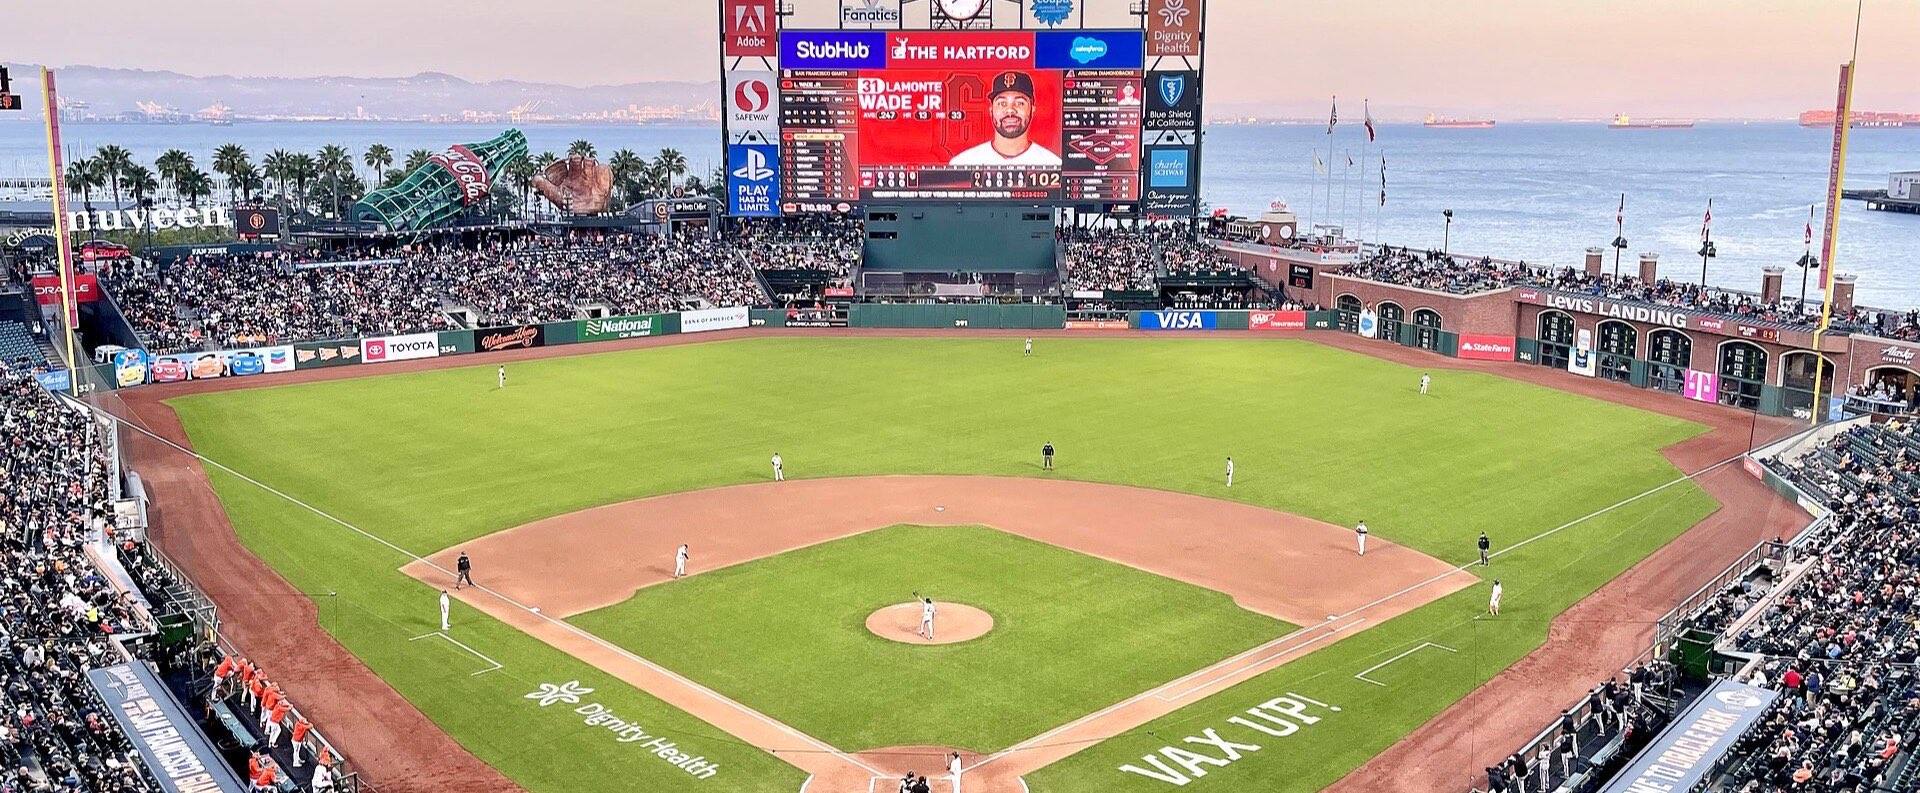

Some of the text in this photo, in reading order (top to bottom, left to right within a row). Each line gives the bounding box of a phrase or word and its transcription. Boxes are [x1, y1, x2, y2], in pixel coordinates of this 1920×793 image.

[843, 8, 898, 21] Fanatics
[737, 36, 765, 47] Adobe
[1154, 31, 1192, 42] Dignity
[796, 40, 870, 59] StubHub
[908, 46, 1030, 59] THE HARTFORD
[862, 80, 942, 92] 31 LAMONTE
[859, 95, 941, 110] WADE JR
[735, 113, 769, 121] SAFEWAY
[1150, 110, 1192, 118] Blue Shield
[1147, 119, 1155, 127] of
[1156, 119, 1194, 127] California
[1154, 159, 1184, 169] charles
[738, 185, 769, 195] PLAY
[1147, 190, 1189, 203] Own your
[1147, 200, 1190, 209] tomorrow
[68, 206, 230, 232] nuveen
[35, 283, 89, 295] ORALE
[1154, 312, 1203, 329] VISA
[1598, 301, 1687, 328] LANDING
[601, 317, 652, 333] National
[481, 326, 538, 350] Welcome Home
[389, 341, 434, 353] TOYOTA
[1472, 343, 1510, 353] State Farm
[1881, 346, 1916, 360] Alaska
[1520, 352, 1532, 361] 365
[1793, 409, 1811, 420] 309
[574, 702, 720, 780] Dignity Health
[1117, 692, 1342, 787] VAX UP!
